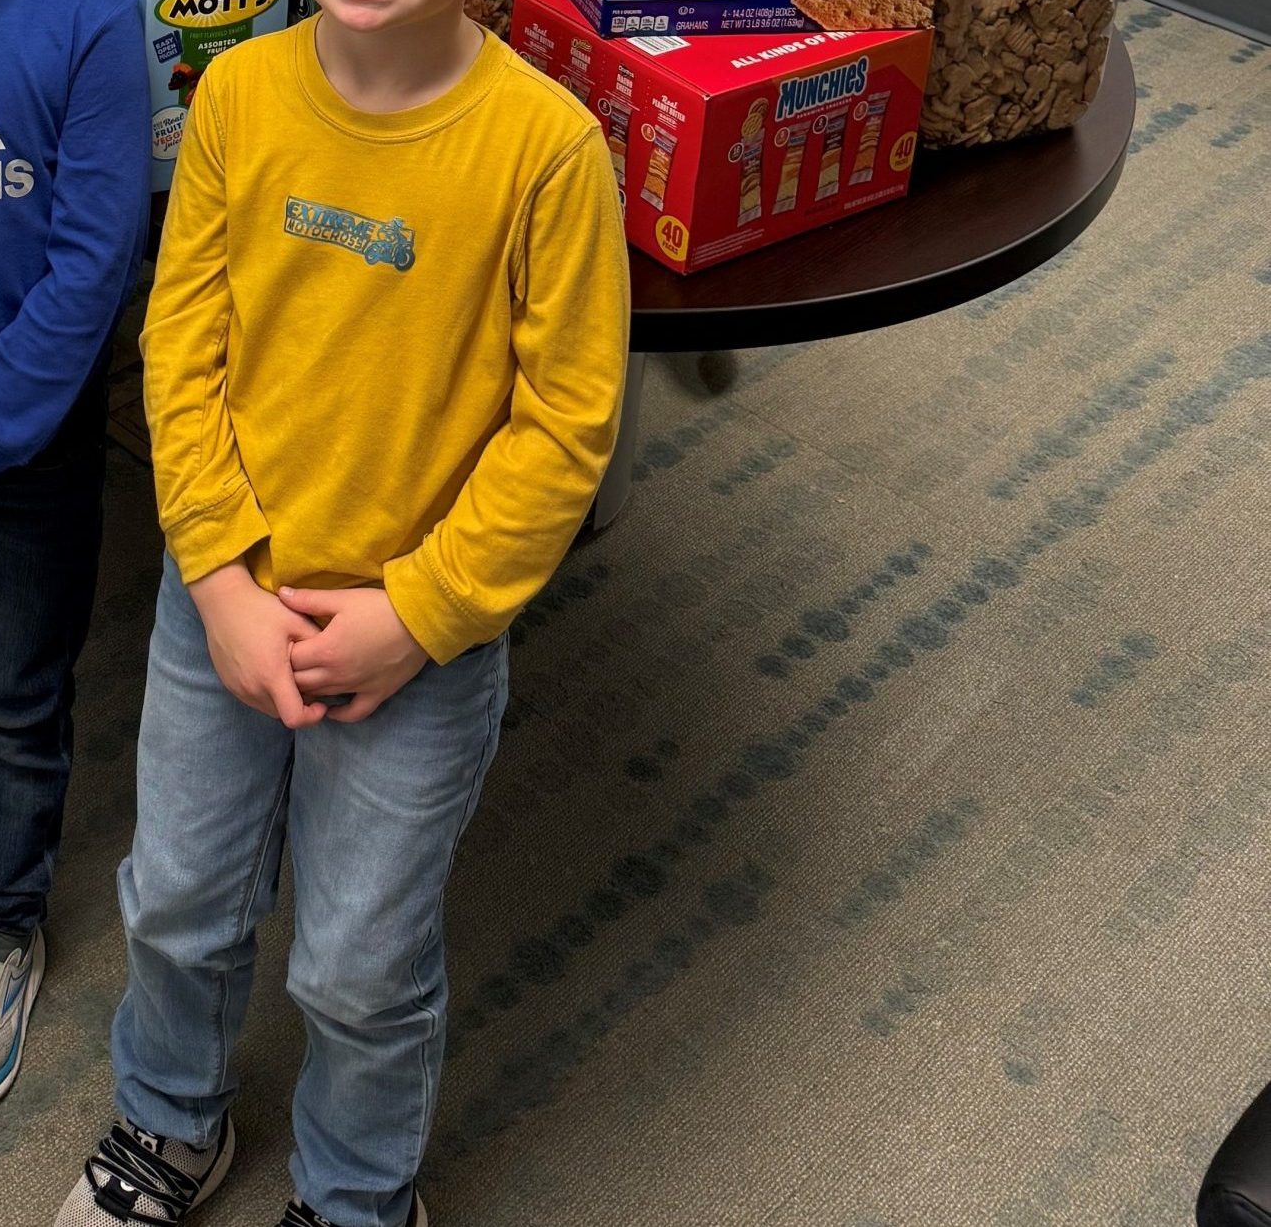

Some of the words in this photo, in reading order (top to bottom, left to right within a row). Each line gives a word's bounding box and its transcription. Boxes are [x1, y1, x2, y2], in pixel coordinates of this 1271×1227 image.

[731, 8, 744, 16] 14.4
[744, 8, 755, 16] OZ
[755, 7, 774, 18] (408g)
[774, 7, 797, 16] BOXES
[676, 21, 709, 30] GRAHAMS
[721, 20, 735, 29] NET
[735, 20, 746, 28] WT
[751, 20, 761, 28] LB
[761, 19, 770, 28] 9.6
[155, 36, 174, 50] EASY
[157, 43, 176, 55] OPEN
[197, 38, 237, 51] ASSORTED
[207, 46, 227, 54] FRUIT
[730, 54, 761, 69] ALL
[757, 40, 807, 61] KINDS
[807, 34, 827, 46] OF
[661, 94, 678, 110] Real
[652, 98, 669, 116] PEANUT
[669, 107, 685, 123] BUTTER
[155, 122, 182, 138] FRUIT
[153, 130, 183, 146] VEGG
[895, 137, 914, 160] 40
[661, 220, 684, 250] 40
